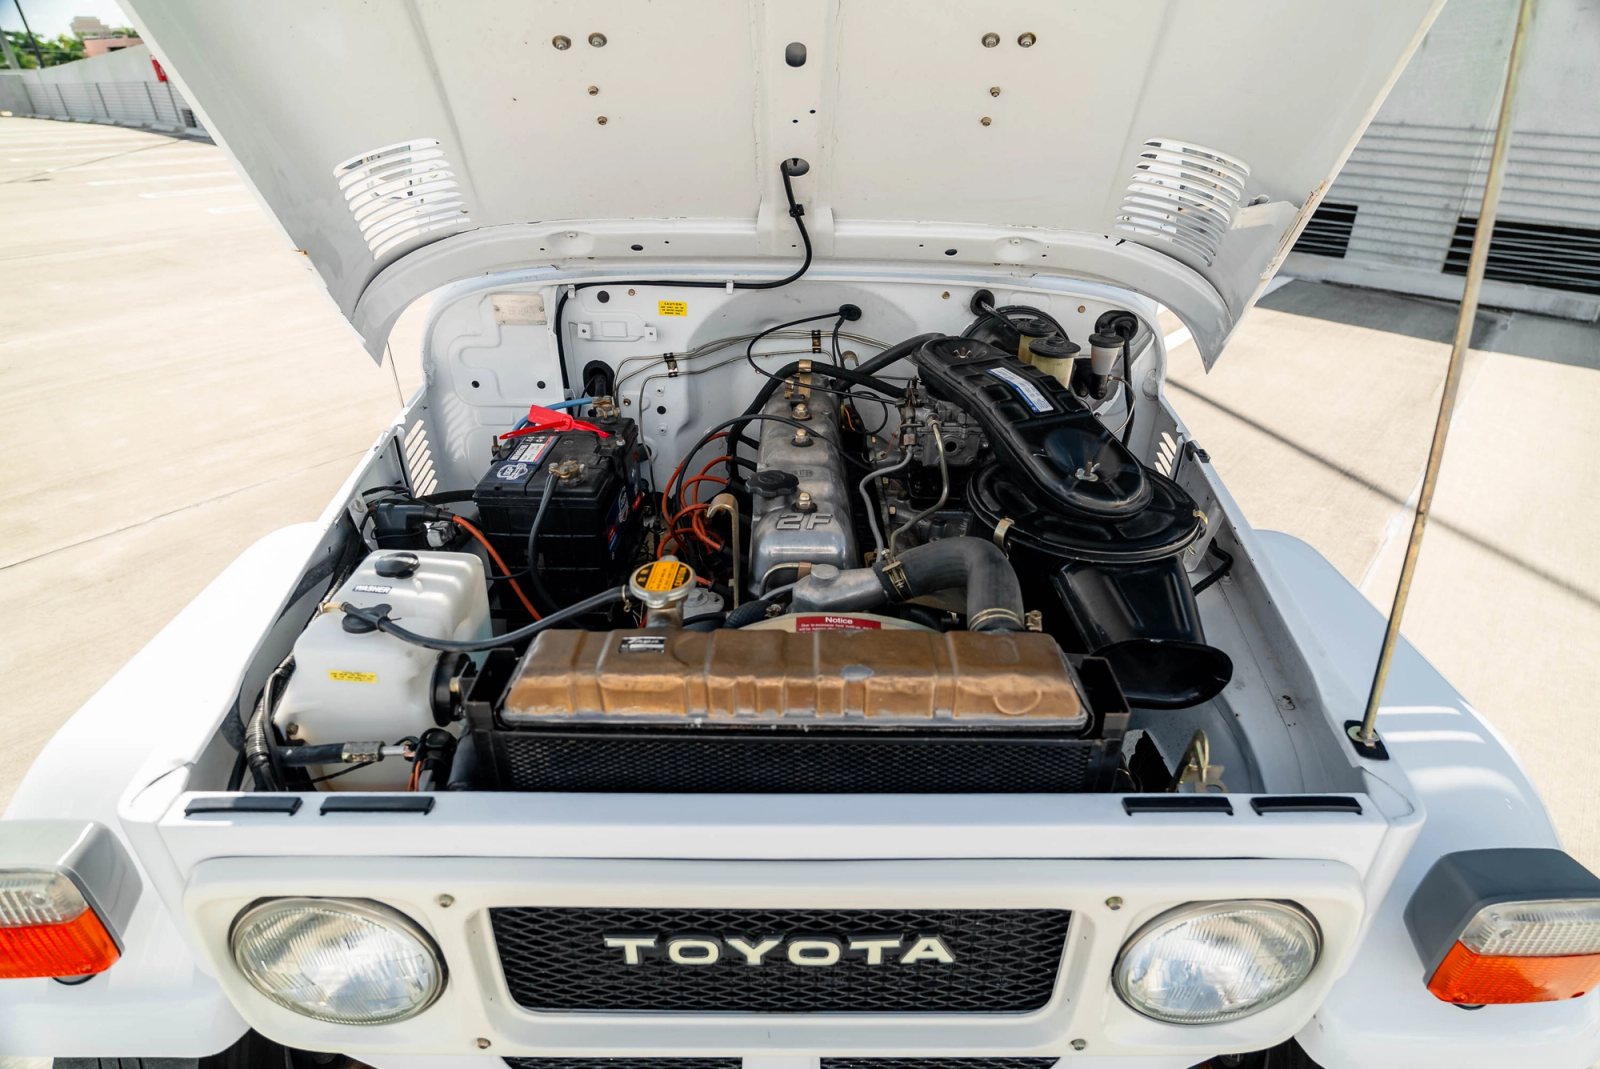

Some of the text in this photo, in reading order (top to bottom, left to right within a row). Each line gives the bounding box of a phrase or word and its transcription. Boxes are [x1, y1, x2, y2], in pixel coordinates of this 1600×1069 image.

[776, 513, 833, 530] 2F
[825, 616, 853, 624] Notice
[604, 937, 954, 966] TOYOTA
